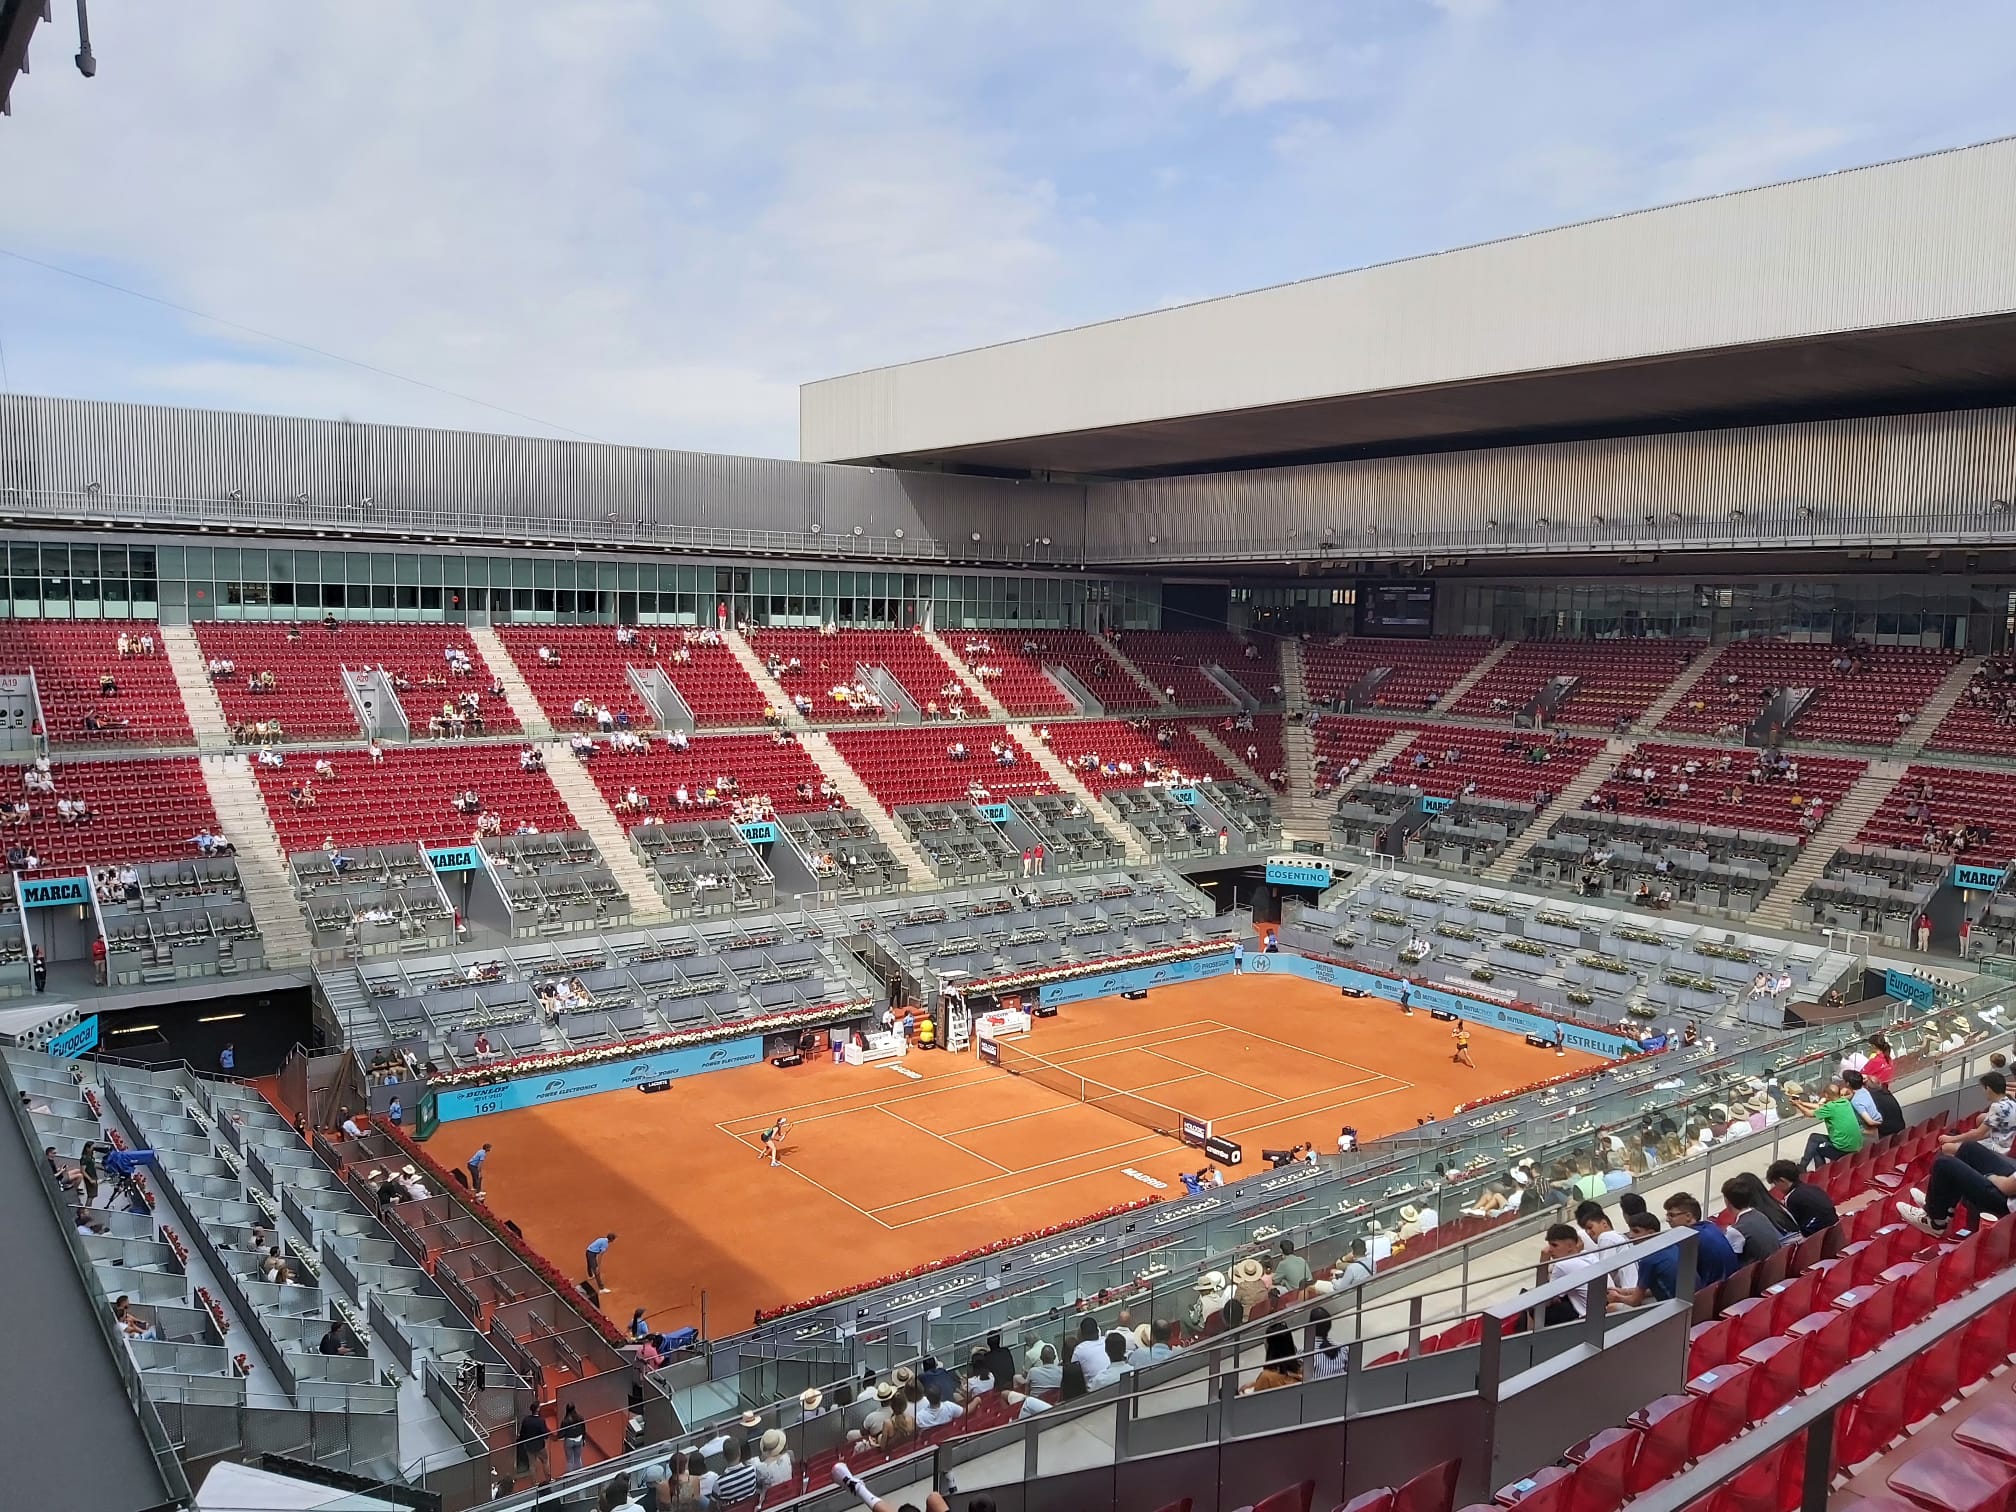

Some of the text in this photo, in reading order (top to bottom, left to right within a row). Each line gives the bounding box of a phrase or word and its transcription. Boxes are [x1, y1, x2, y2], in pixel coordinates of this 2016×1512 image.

[1268, 870, 1325, 882] COSENTINO
[24, 884, 82, 903] MARCA
[1201, 959, 1229, 969] PROSEGUR
[1316, 963, 1334, 973] MUTUA
[1316, 970, 1335, 979] MADRID
[1889, 973, 1930, 1005] Europcar
[53, 1025, 94, 1057] Europcar
[1567, 1034, 1614, 1054] ESTRELLA
[701, 1060, 721, 1068] POWER
[466, 1085, 509, 1098] DUNLOP
[536, 1083, 598, 1099] POWER ELECTRONICS
[475, 1101, 496, 1114] 169
[1120, 1167, 1168, 1189] MADRID
